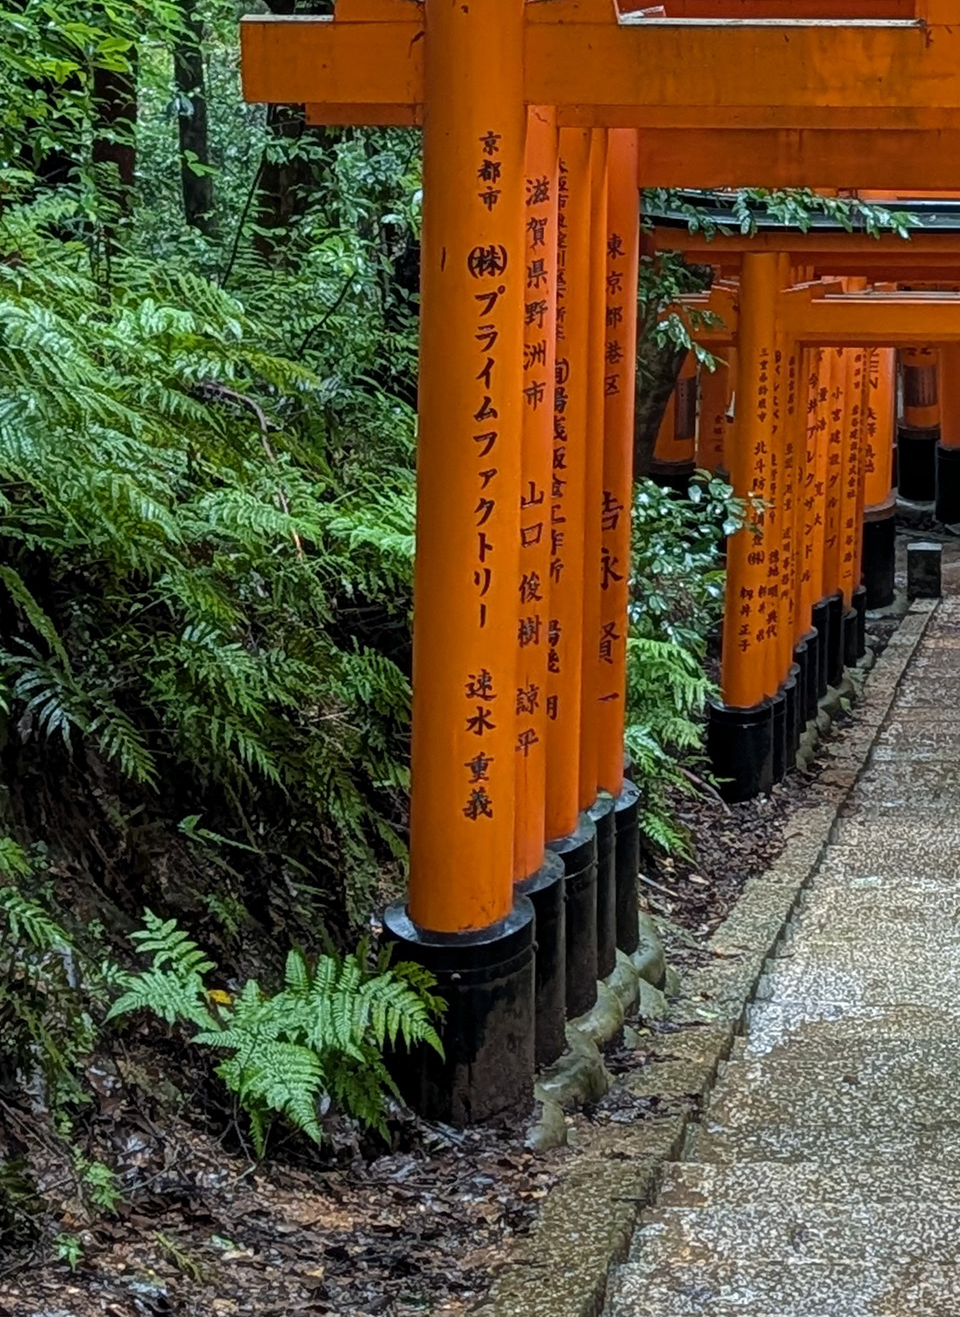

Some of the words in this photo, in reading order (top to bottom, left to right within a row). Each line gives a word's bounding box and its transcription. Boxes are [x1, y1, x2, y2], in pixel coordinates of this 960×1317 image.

[477, 131, 502, 212] 京都市
[522, 175, 550, 411] 滋賀県野洲市
